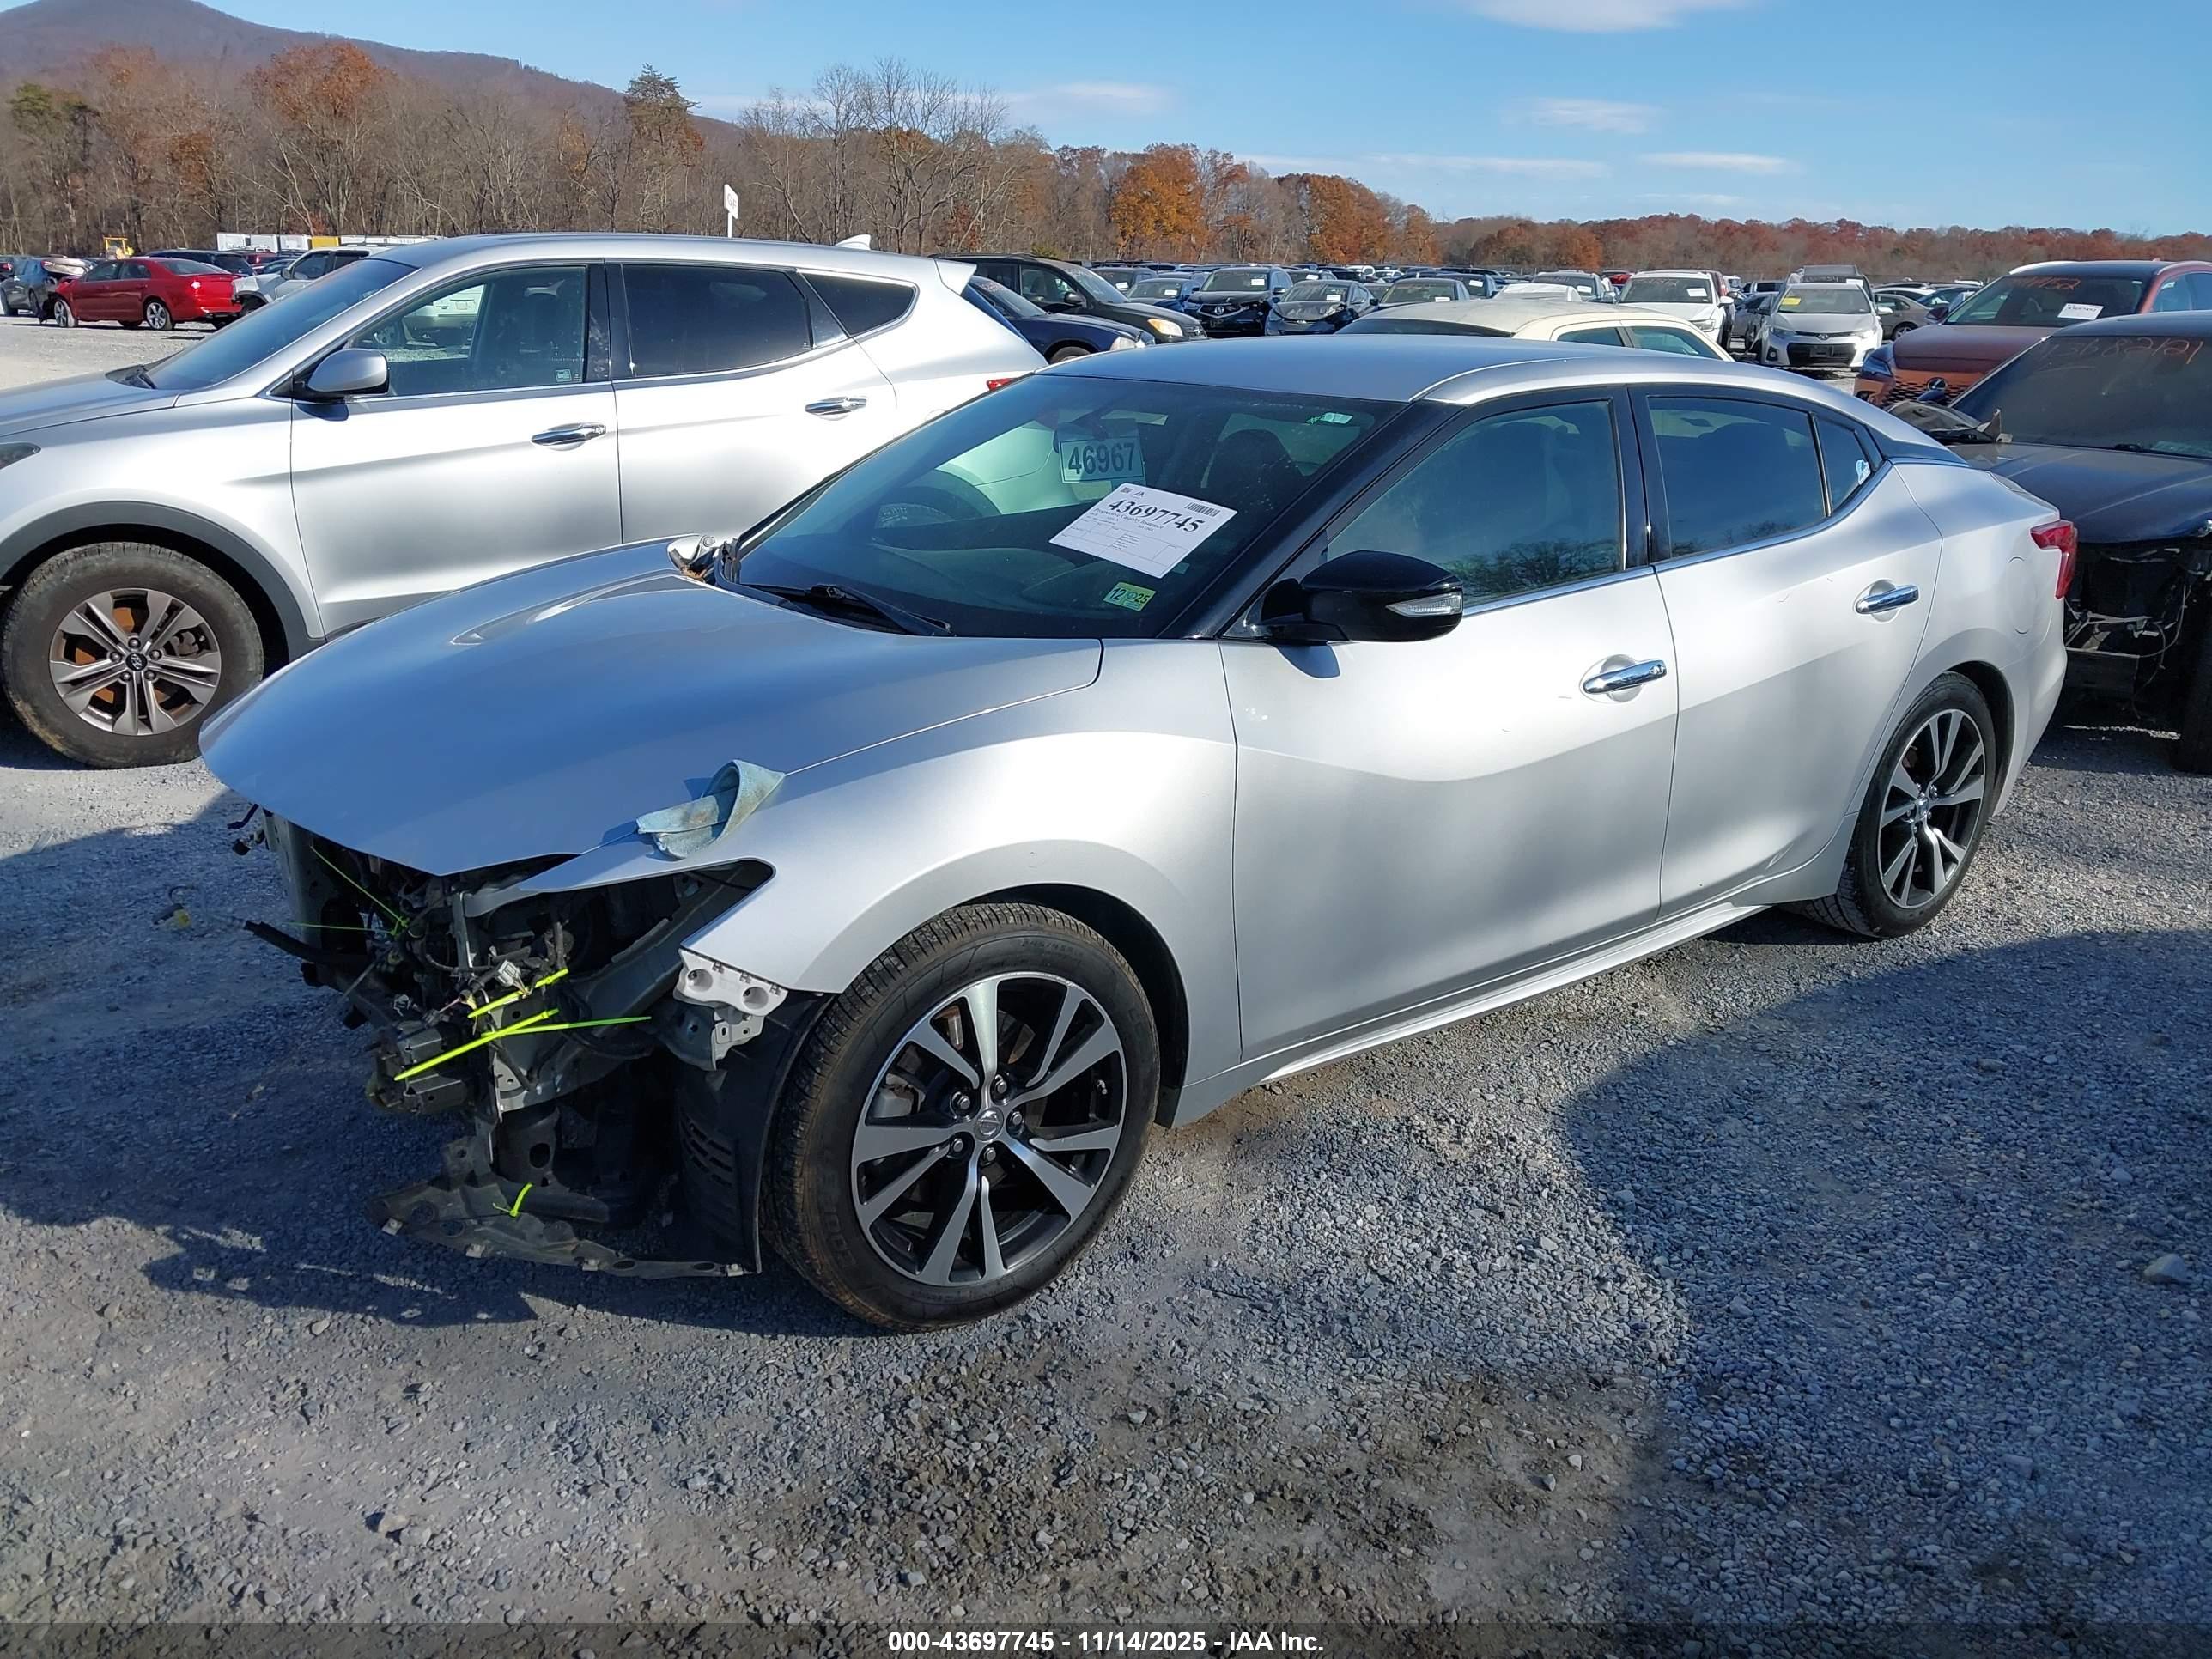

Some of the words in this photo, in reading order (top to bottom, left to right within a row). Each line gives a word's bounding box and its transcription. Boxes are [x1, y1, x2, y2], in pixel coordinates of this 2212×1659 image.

[1067, 443, 1135, 475] 46967
[1109, 499, 1206, 532] 43697745
[1109, 587, 1127, 600] 12
[1134, 593, 1151, 604] 25
